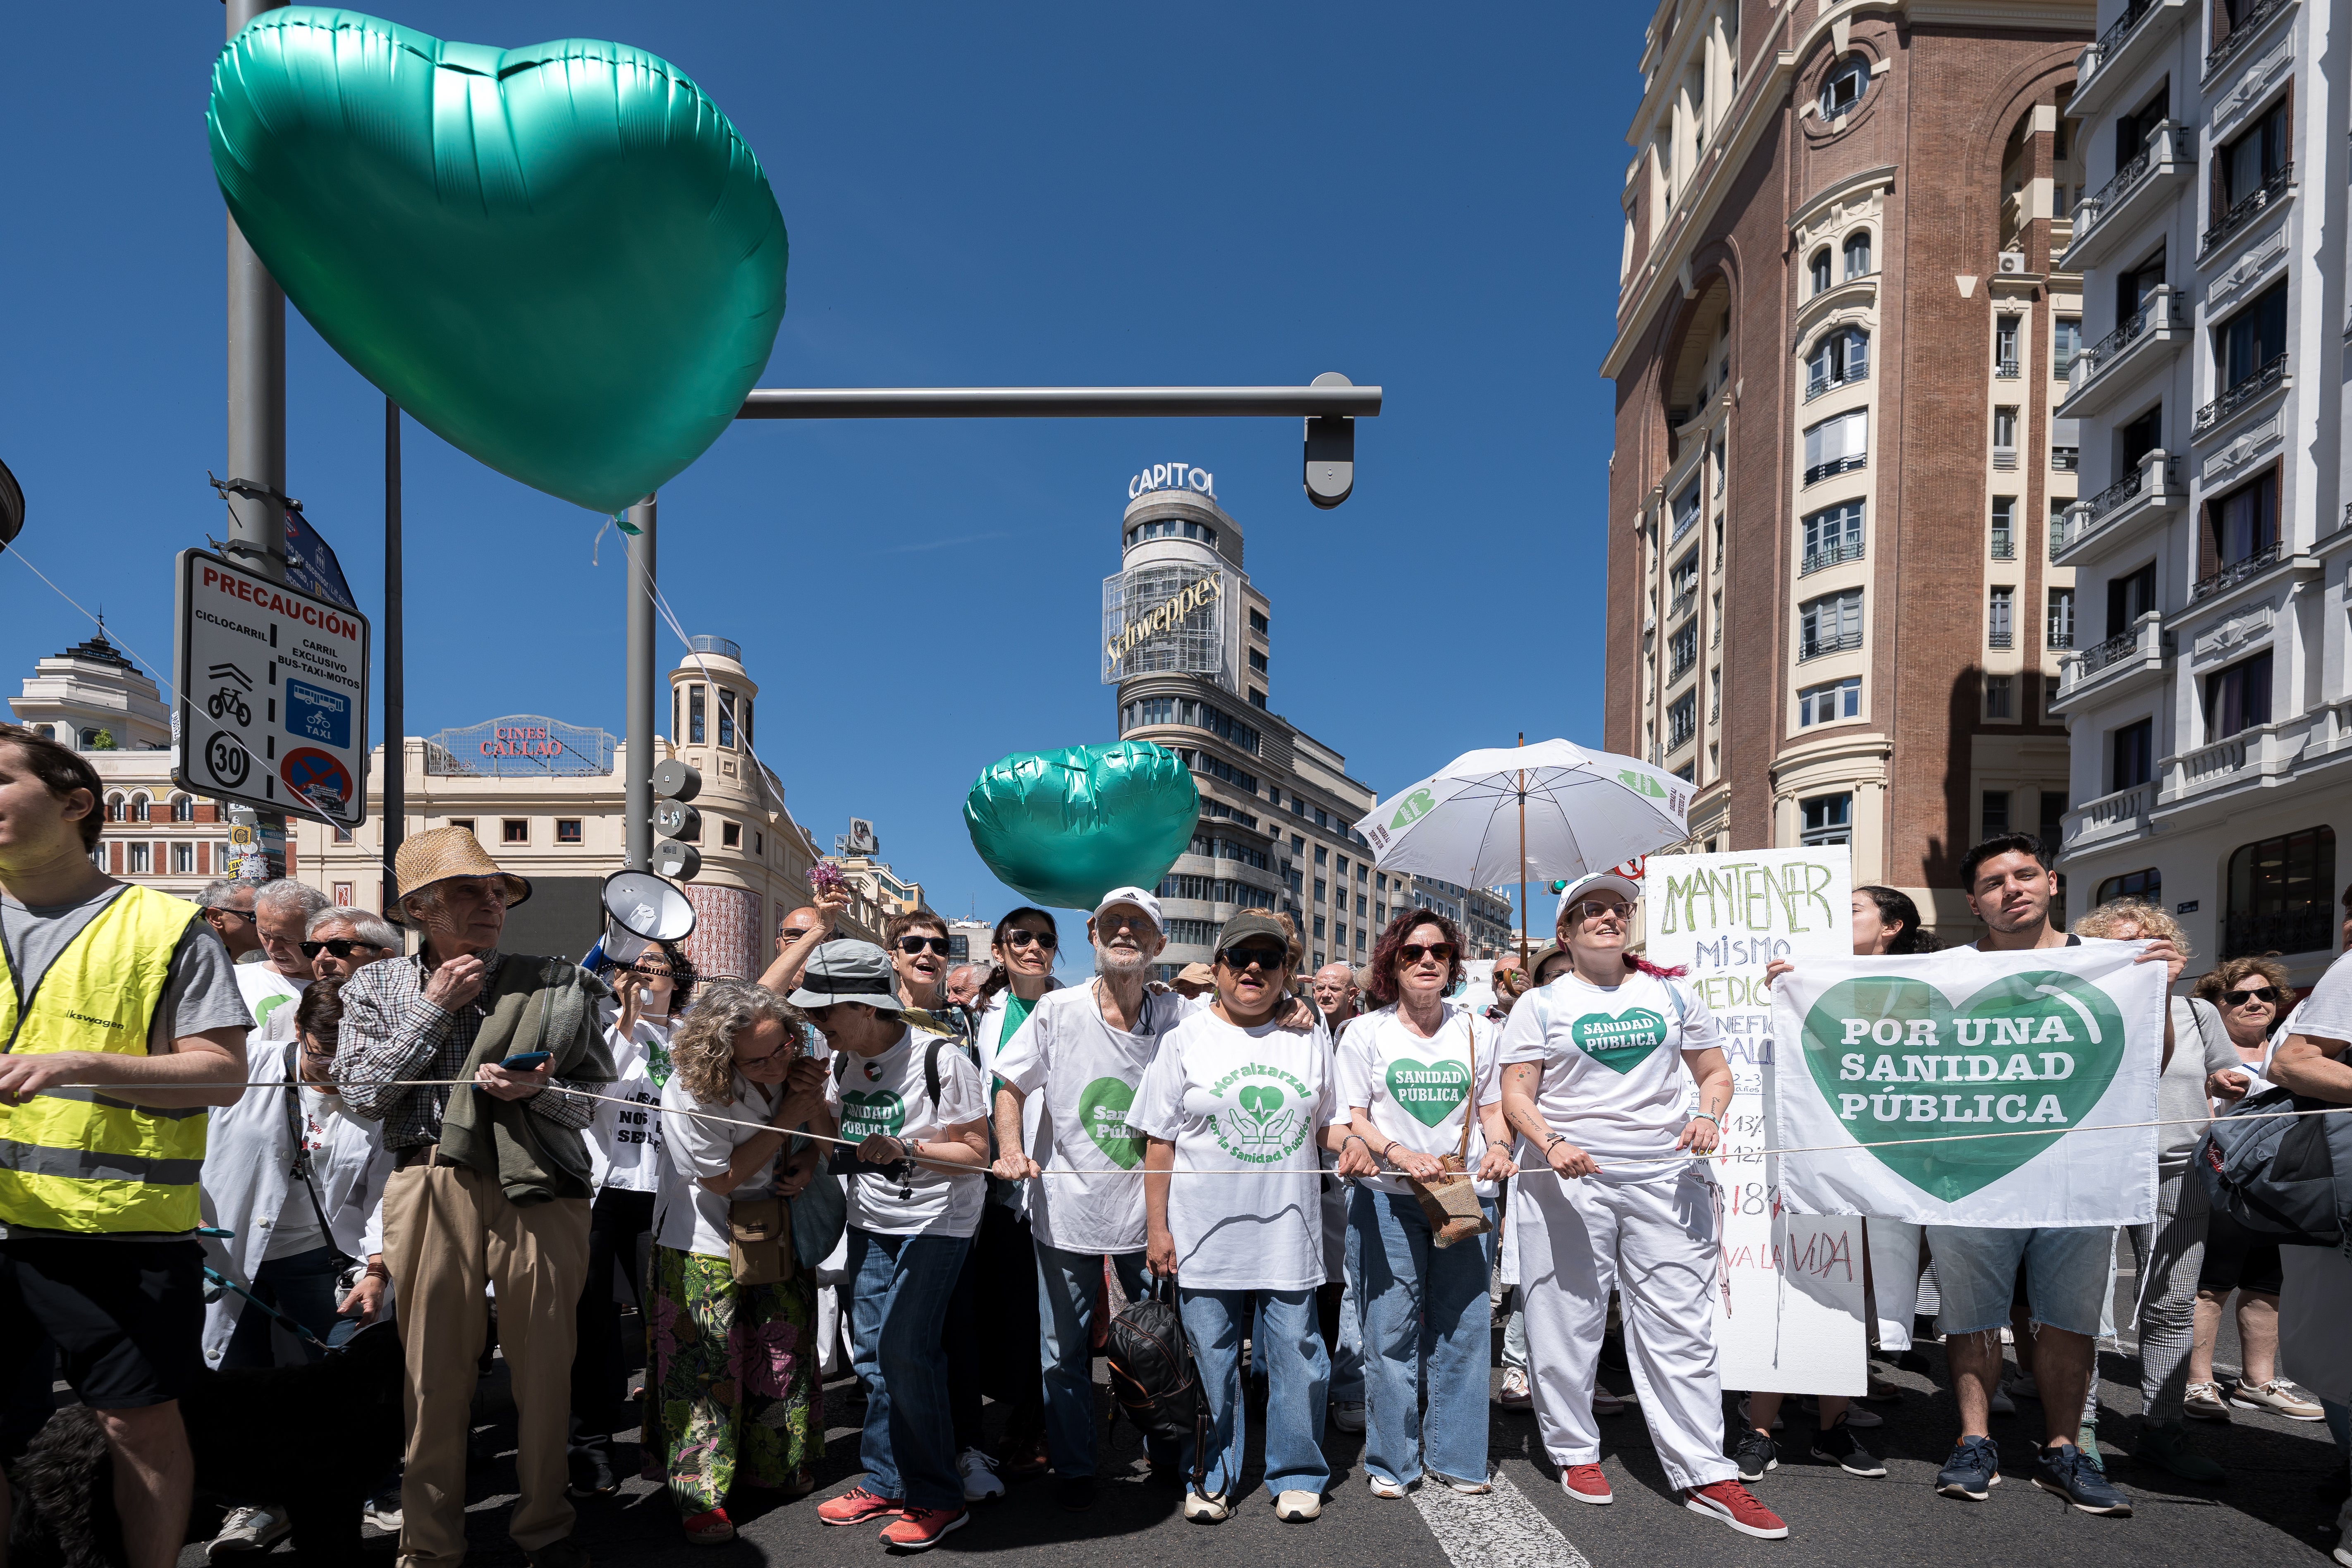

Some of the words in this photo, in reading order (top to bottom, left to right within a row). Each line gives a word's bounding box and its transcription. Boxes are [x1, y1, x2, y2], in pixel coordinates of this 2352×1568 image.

[1128, 463, 1217, 501] CAPITOL
[306, 560, 328, 588] ascensor
[203, 566, 356, 641] PRECAUCIÓN
[195, 609, 268, 643] CICLOCARRIL
[1107, 570, 1221, 674] Schweppes
[292, 647, 348, 673] EXCLUSIVO
[302, 638, 338, 658] CARRIL
[277, 654, 360, 690] BUS-TAXI-MOTOS
[306, 725, 332, 739] TAXI
[496, 727, 546, 739] CINES
[215, 743, 241, 773] 30
[480, 741, 562, 755] CALLAO
[1661, 861, 1833, 934] MANTENER
[1583, 1018, 1654, 1035] SANIDAD
[1840, 1018, 1939, 1046] POR
[1953, 1016, 2074, 1046] UNA
[1585, 1033, 1657, 1052] PÚBLICA
[1209, 1062, 1312, 1098] Moralzarzal
[1395, 1070, 1462, 1084] SANIDAD
[1840, 1052, 2075, 1082] SANIDAD
[1398, 1083, 1459, 1102] PÚBLICA
[1838, 1085, 2068, 1123] PÚBLICA
[1206, 1114, 1221, 1136] Por
[1218, 1136, 1229, 1150] la
[1230, 1146, 1283, 1164] Sanidad
[1283, 1116, 1312, 1156] Pública
[1733, 1115, 1766, 1137] 13%
[1742, 1183, 1778, 1215] 8%
[1762, 1243, 1785, 1271] LA
